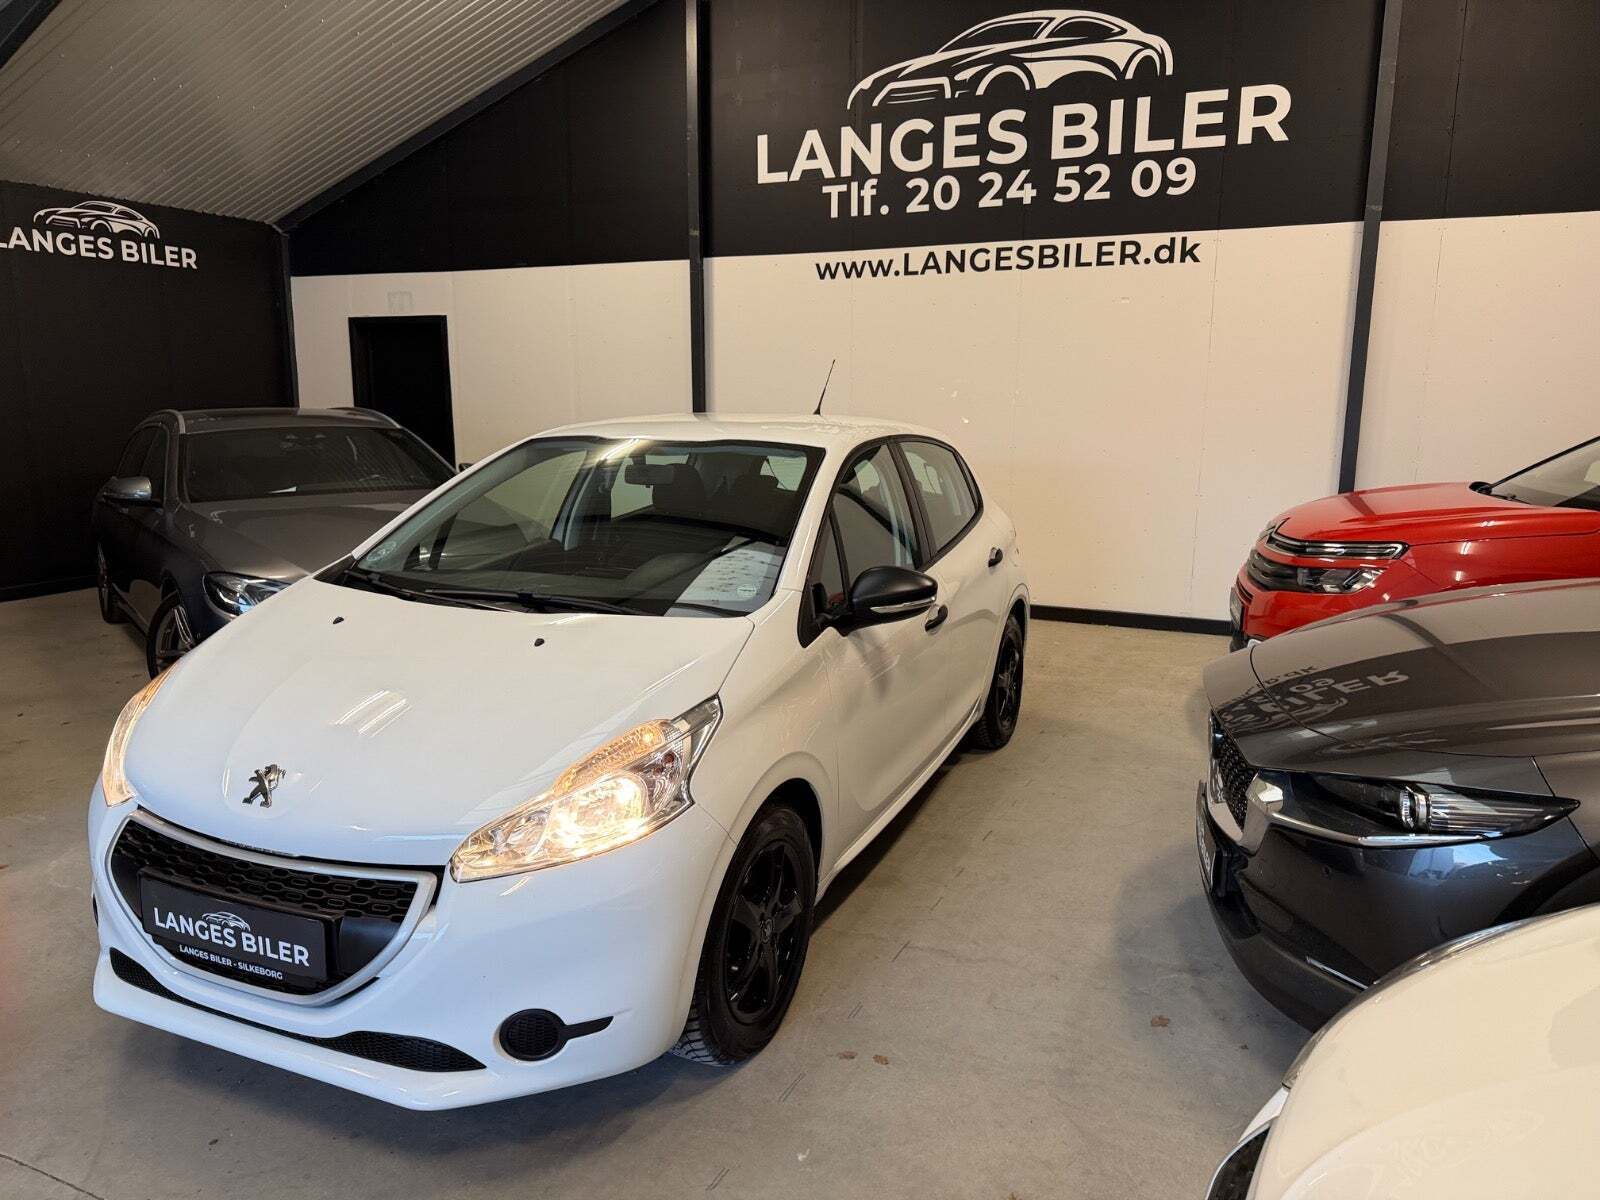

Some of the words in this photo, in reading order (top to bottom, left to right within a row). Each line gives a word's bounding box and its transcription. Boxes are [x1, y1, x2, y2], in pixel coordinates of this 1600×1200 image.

[757, 108, 1028, 185] LANGES
[1051, 84, 1292, 160] BILER
[822, 177, 890, 219] Tlf.
[905, 174, 961, 214] 20
[978, 169, 1037, 209] 24
[1053, 163, 1111, 203] 52
[1131, 156, 1197, 198] 09
[120, 239, 198, 270] BILER
[815, 236, 1201, 280] www.LANGESBILER.dk
[154, 907, 237, 949] LANGES
[240, 931, 310, 967] BILER
[179, 944, 209, 960] LANGES
[209, 953, 233, 967] BILER
[237, 961, 283, 980] SILKEBORG
